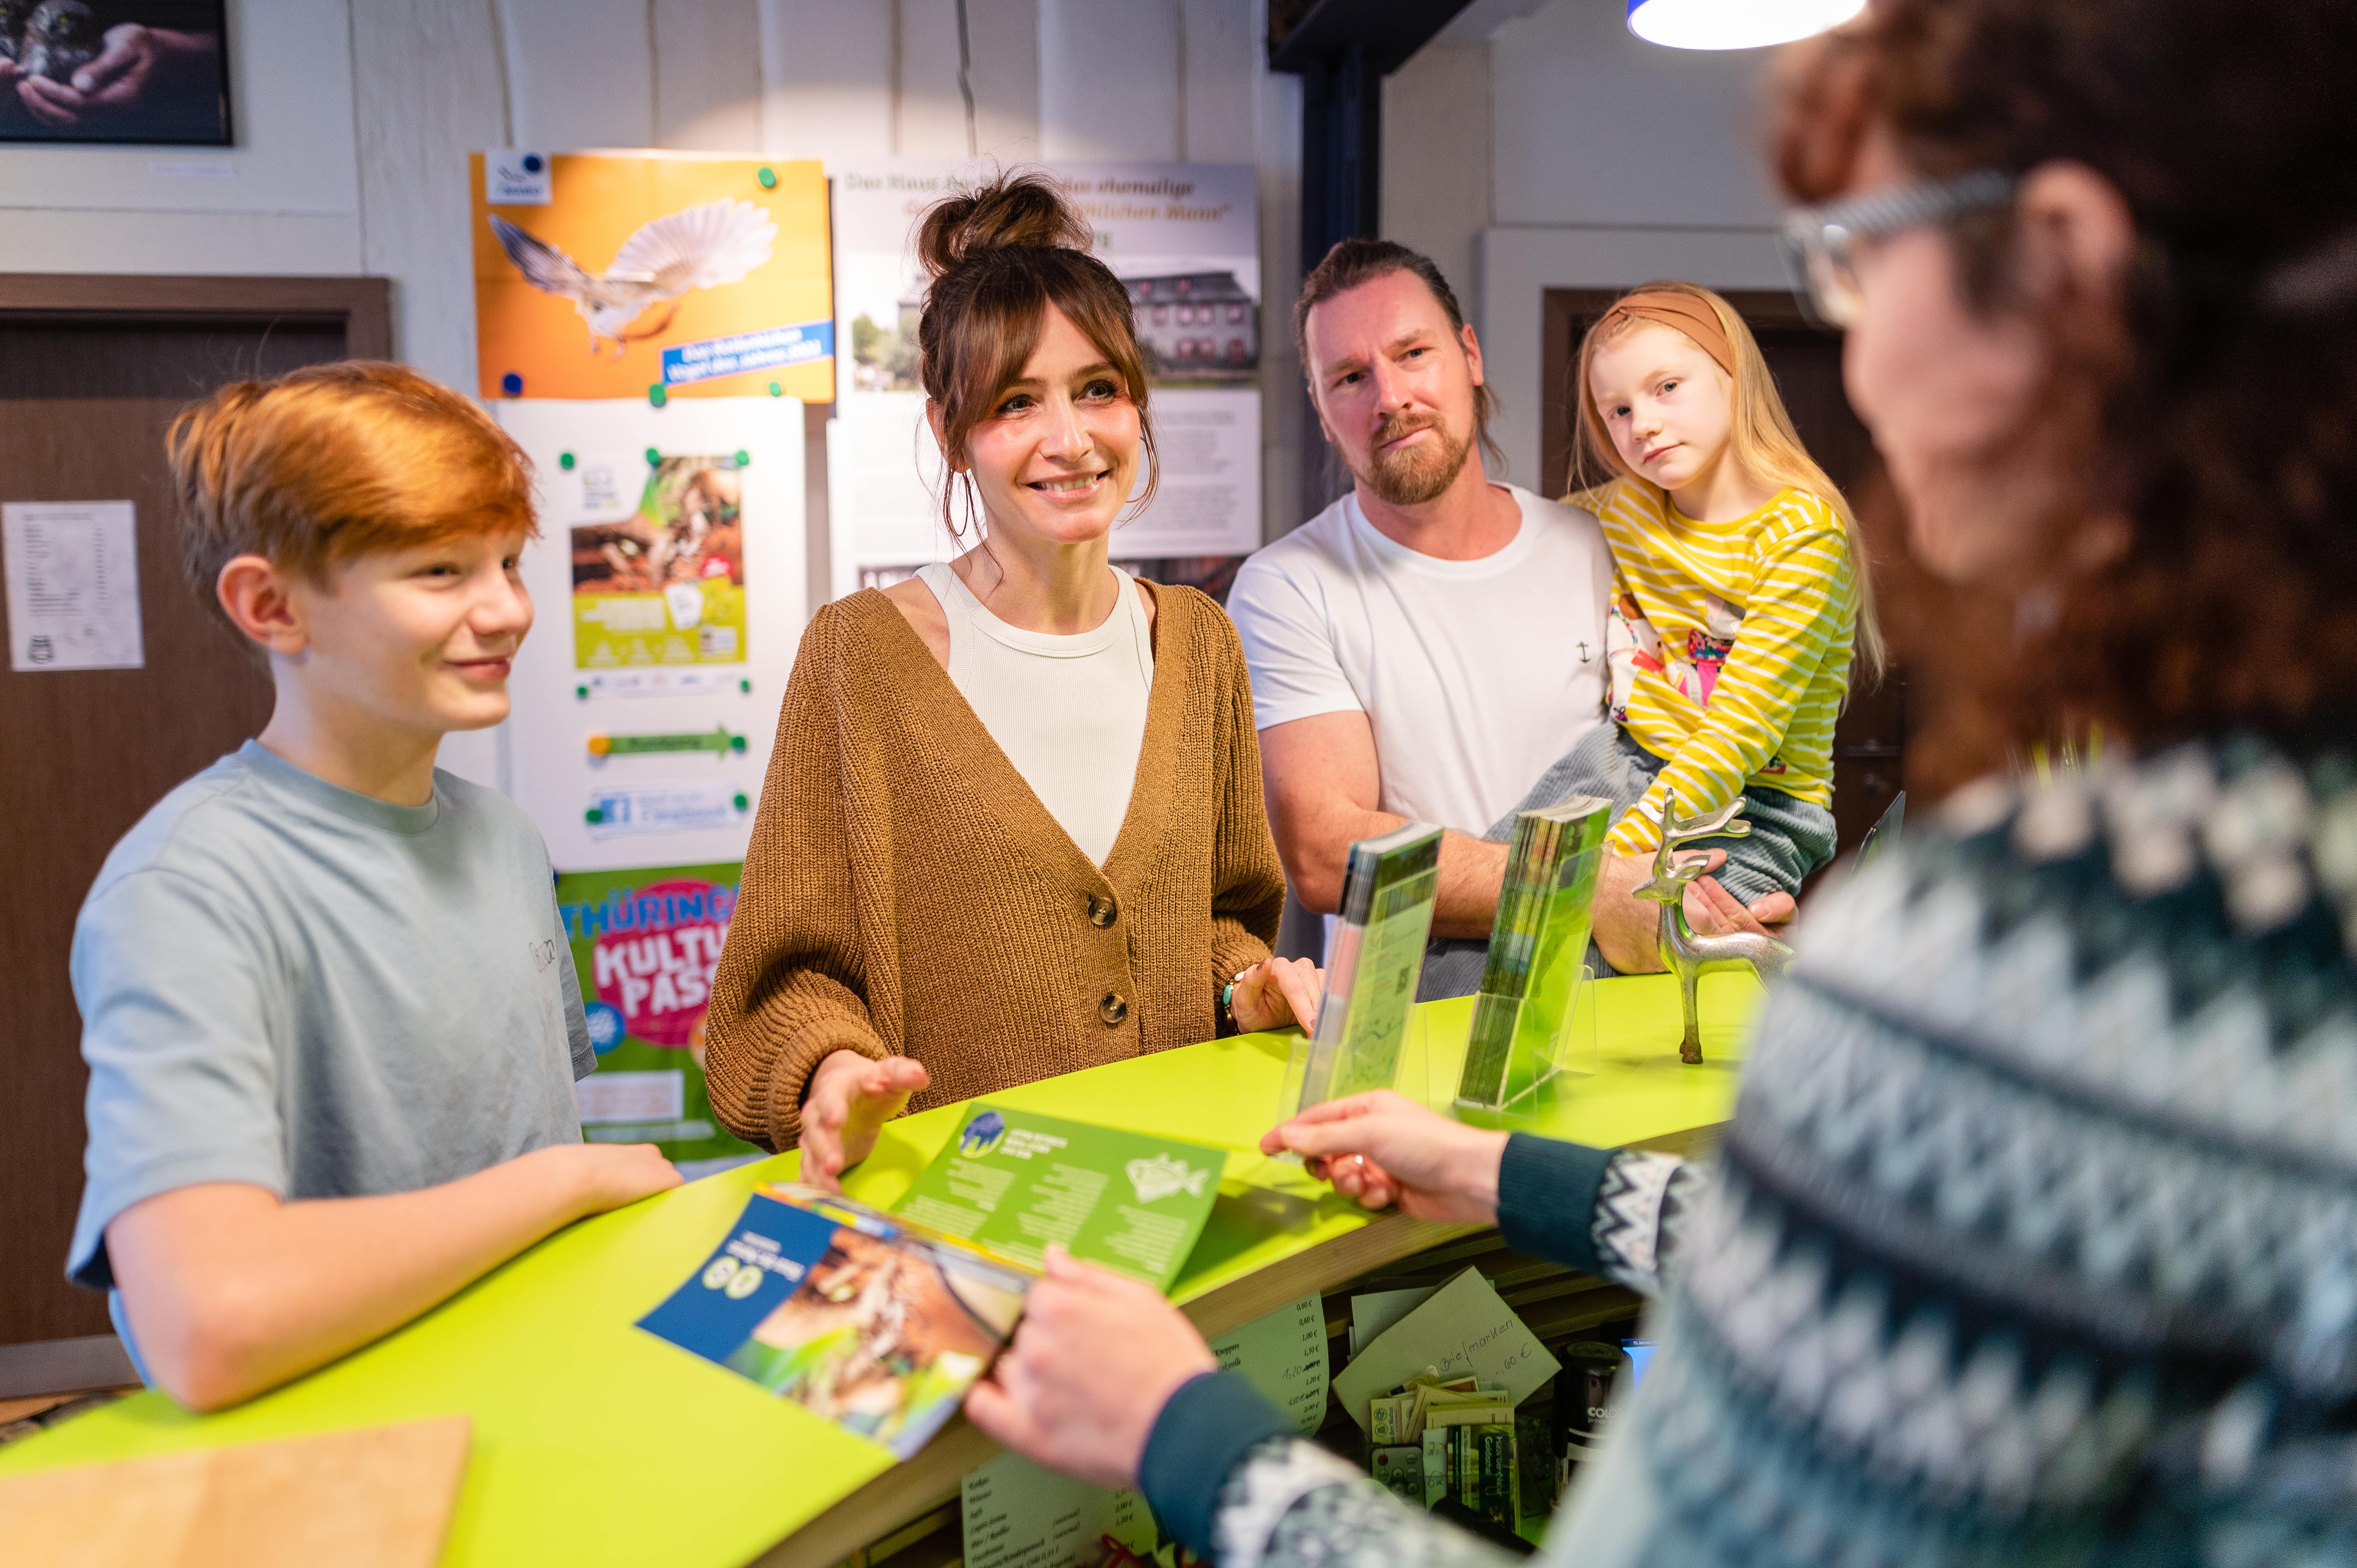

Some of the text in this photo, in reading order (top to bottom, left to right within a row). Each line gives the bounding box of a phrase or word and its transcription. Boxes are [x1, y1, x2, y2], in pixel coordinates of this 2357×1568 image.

[558, 881, 740, 941] THÜRING
[594, 923, 728, 989] KULTU
[1302, 1331, 1313, 1342] 1,00
[1440, 1319, 1513, 1372] Briefmarken
[1521, 1342, 1532, 1359] €
[1588, 1406, 1618, 1418] COLO
